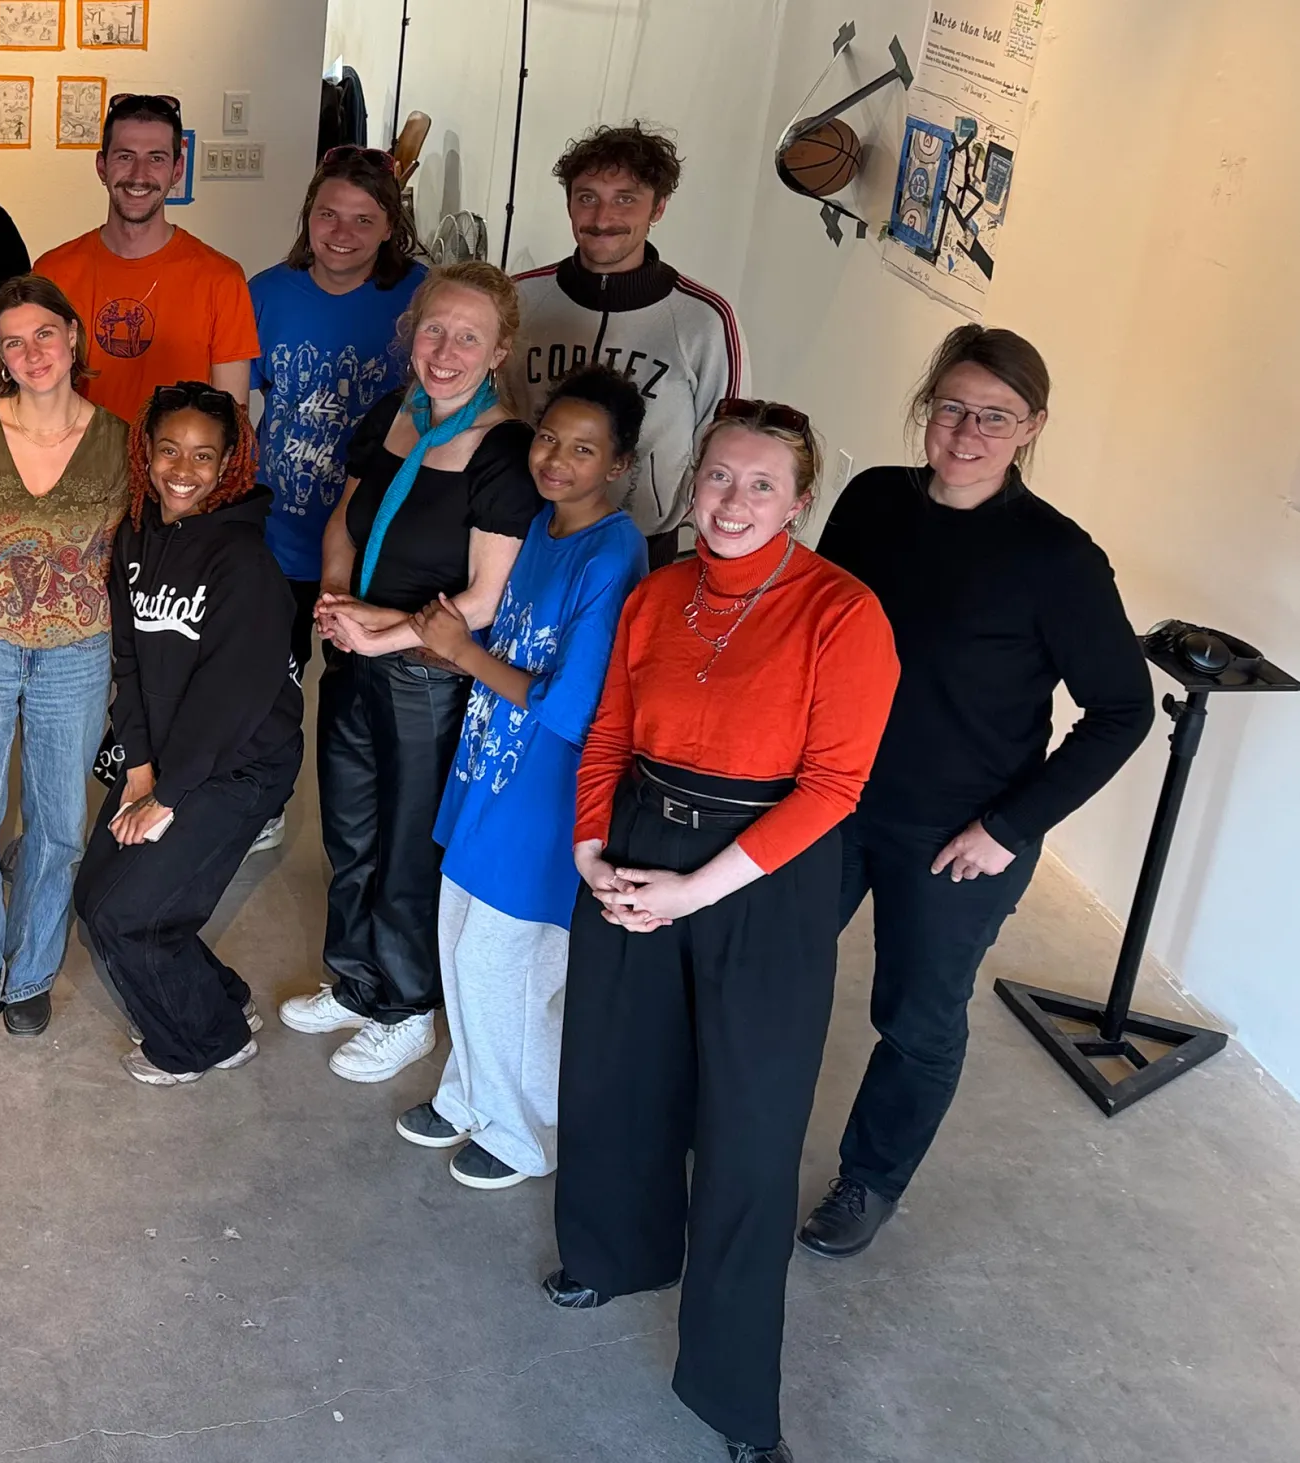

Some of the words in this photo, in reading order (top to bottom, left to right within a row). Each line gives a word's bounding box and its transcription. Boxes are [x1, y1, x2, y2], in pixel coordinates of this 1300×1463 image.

[960, 20, 980, 36] than
[982, 26, 1002, 43] ball
[527, 344, 670, 399] CORTEZ
